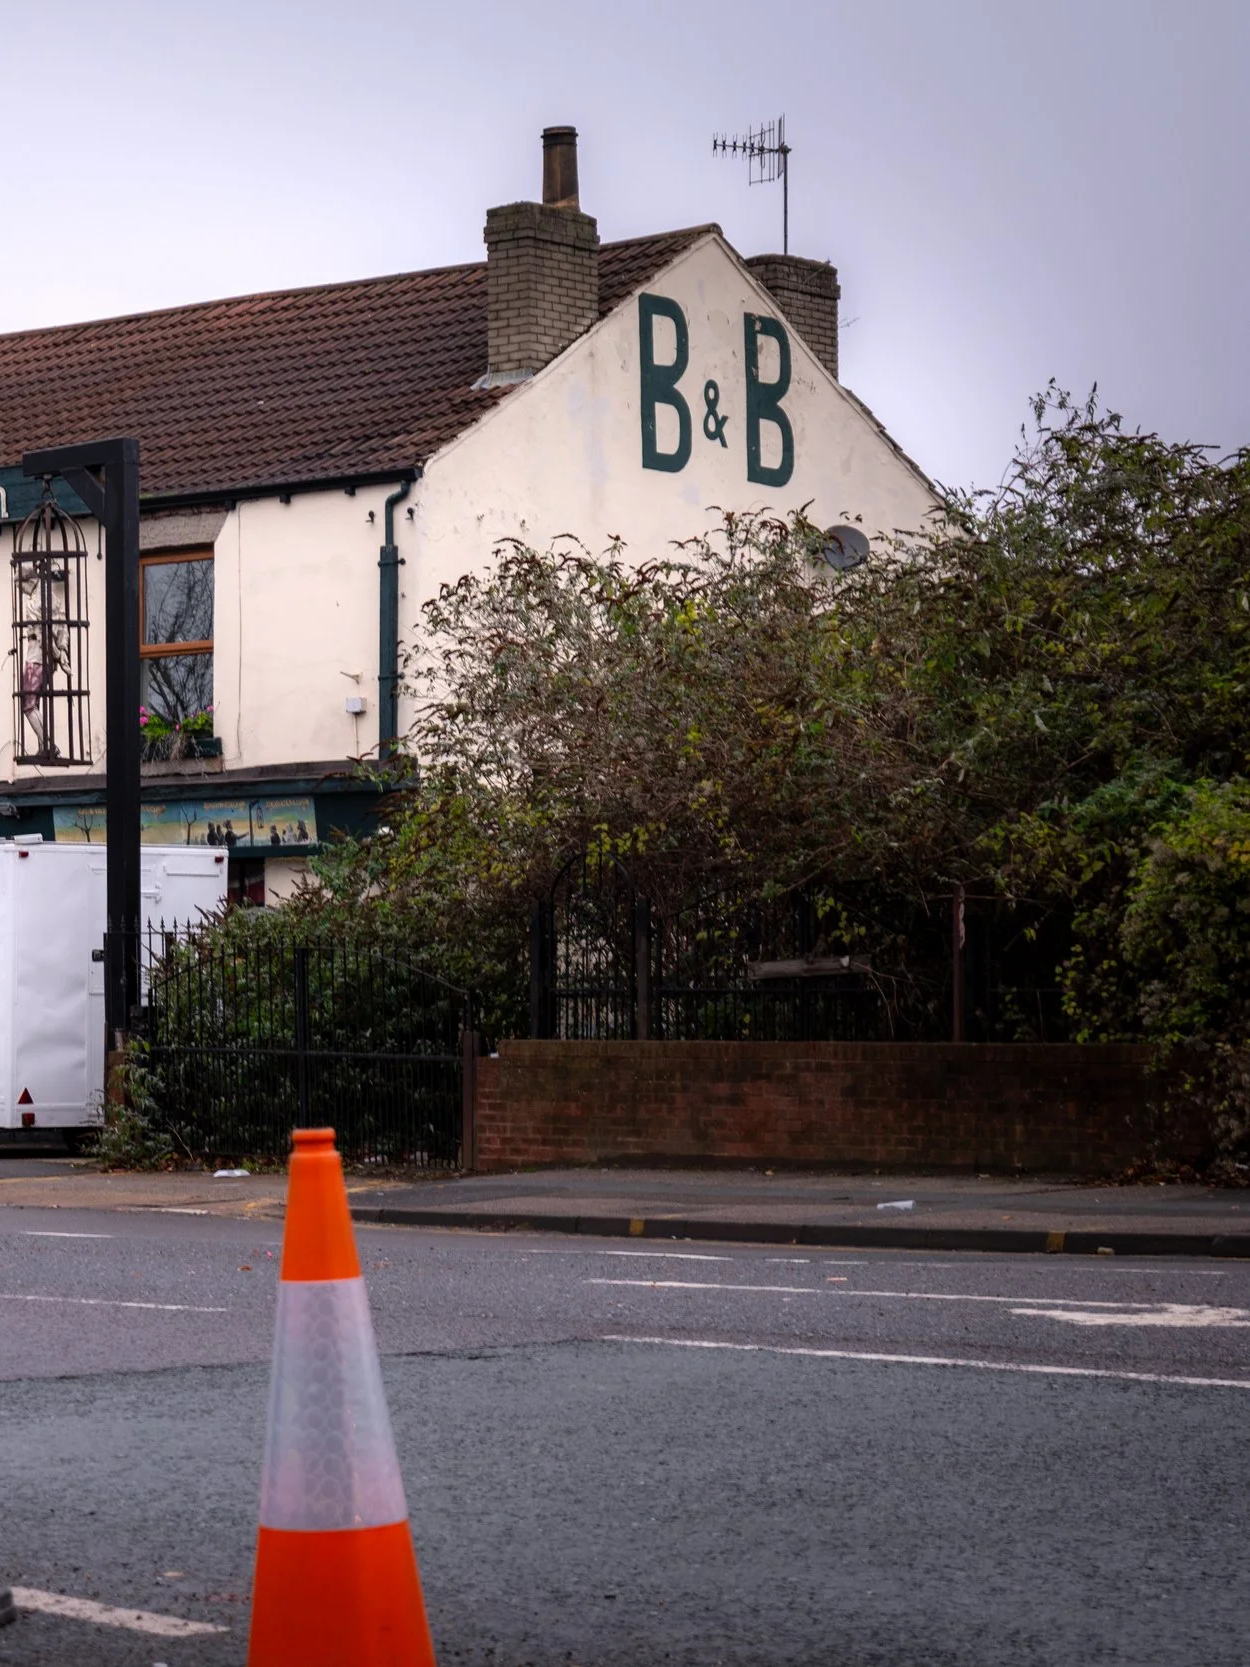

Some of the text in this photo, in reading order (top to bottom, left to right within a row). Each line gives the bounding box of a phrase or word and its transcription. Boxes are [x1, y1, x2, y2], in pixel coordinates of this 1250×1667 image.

[638, 292, 794, 487] B & B
